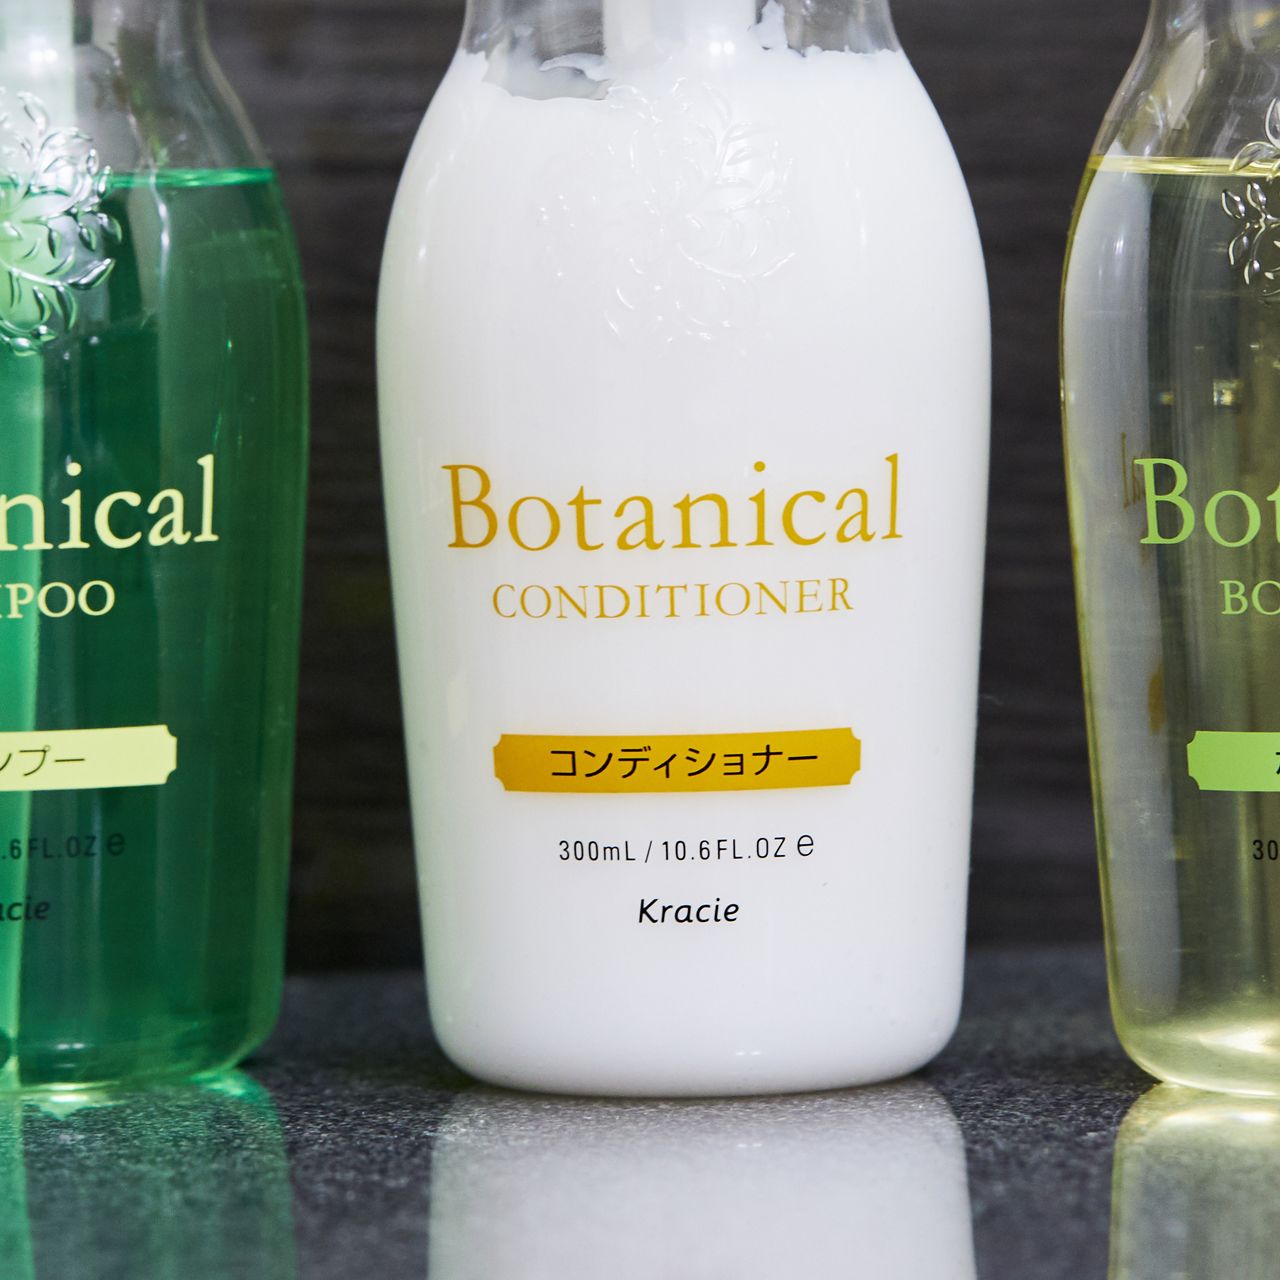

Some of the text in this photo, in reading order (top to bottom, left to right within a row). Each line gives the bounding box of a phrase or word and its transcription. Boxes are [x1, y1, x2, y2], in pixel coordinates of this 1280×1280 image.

[441, 453, 903, 551] Botanical
[492, 578, 854, 618] CONDITIONER
[550, 744, 818, 779] コンディショナー
[558, 840, 636, 861] 300mL
[638, 897, 739, 924] Kracie
